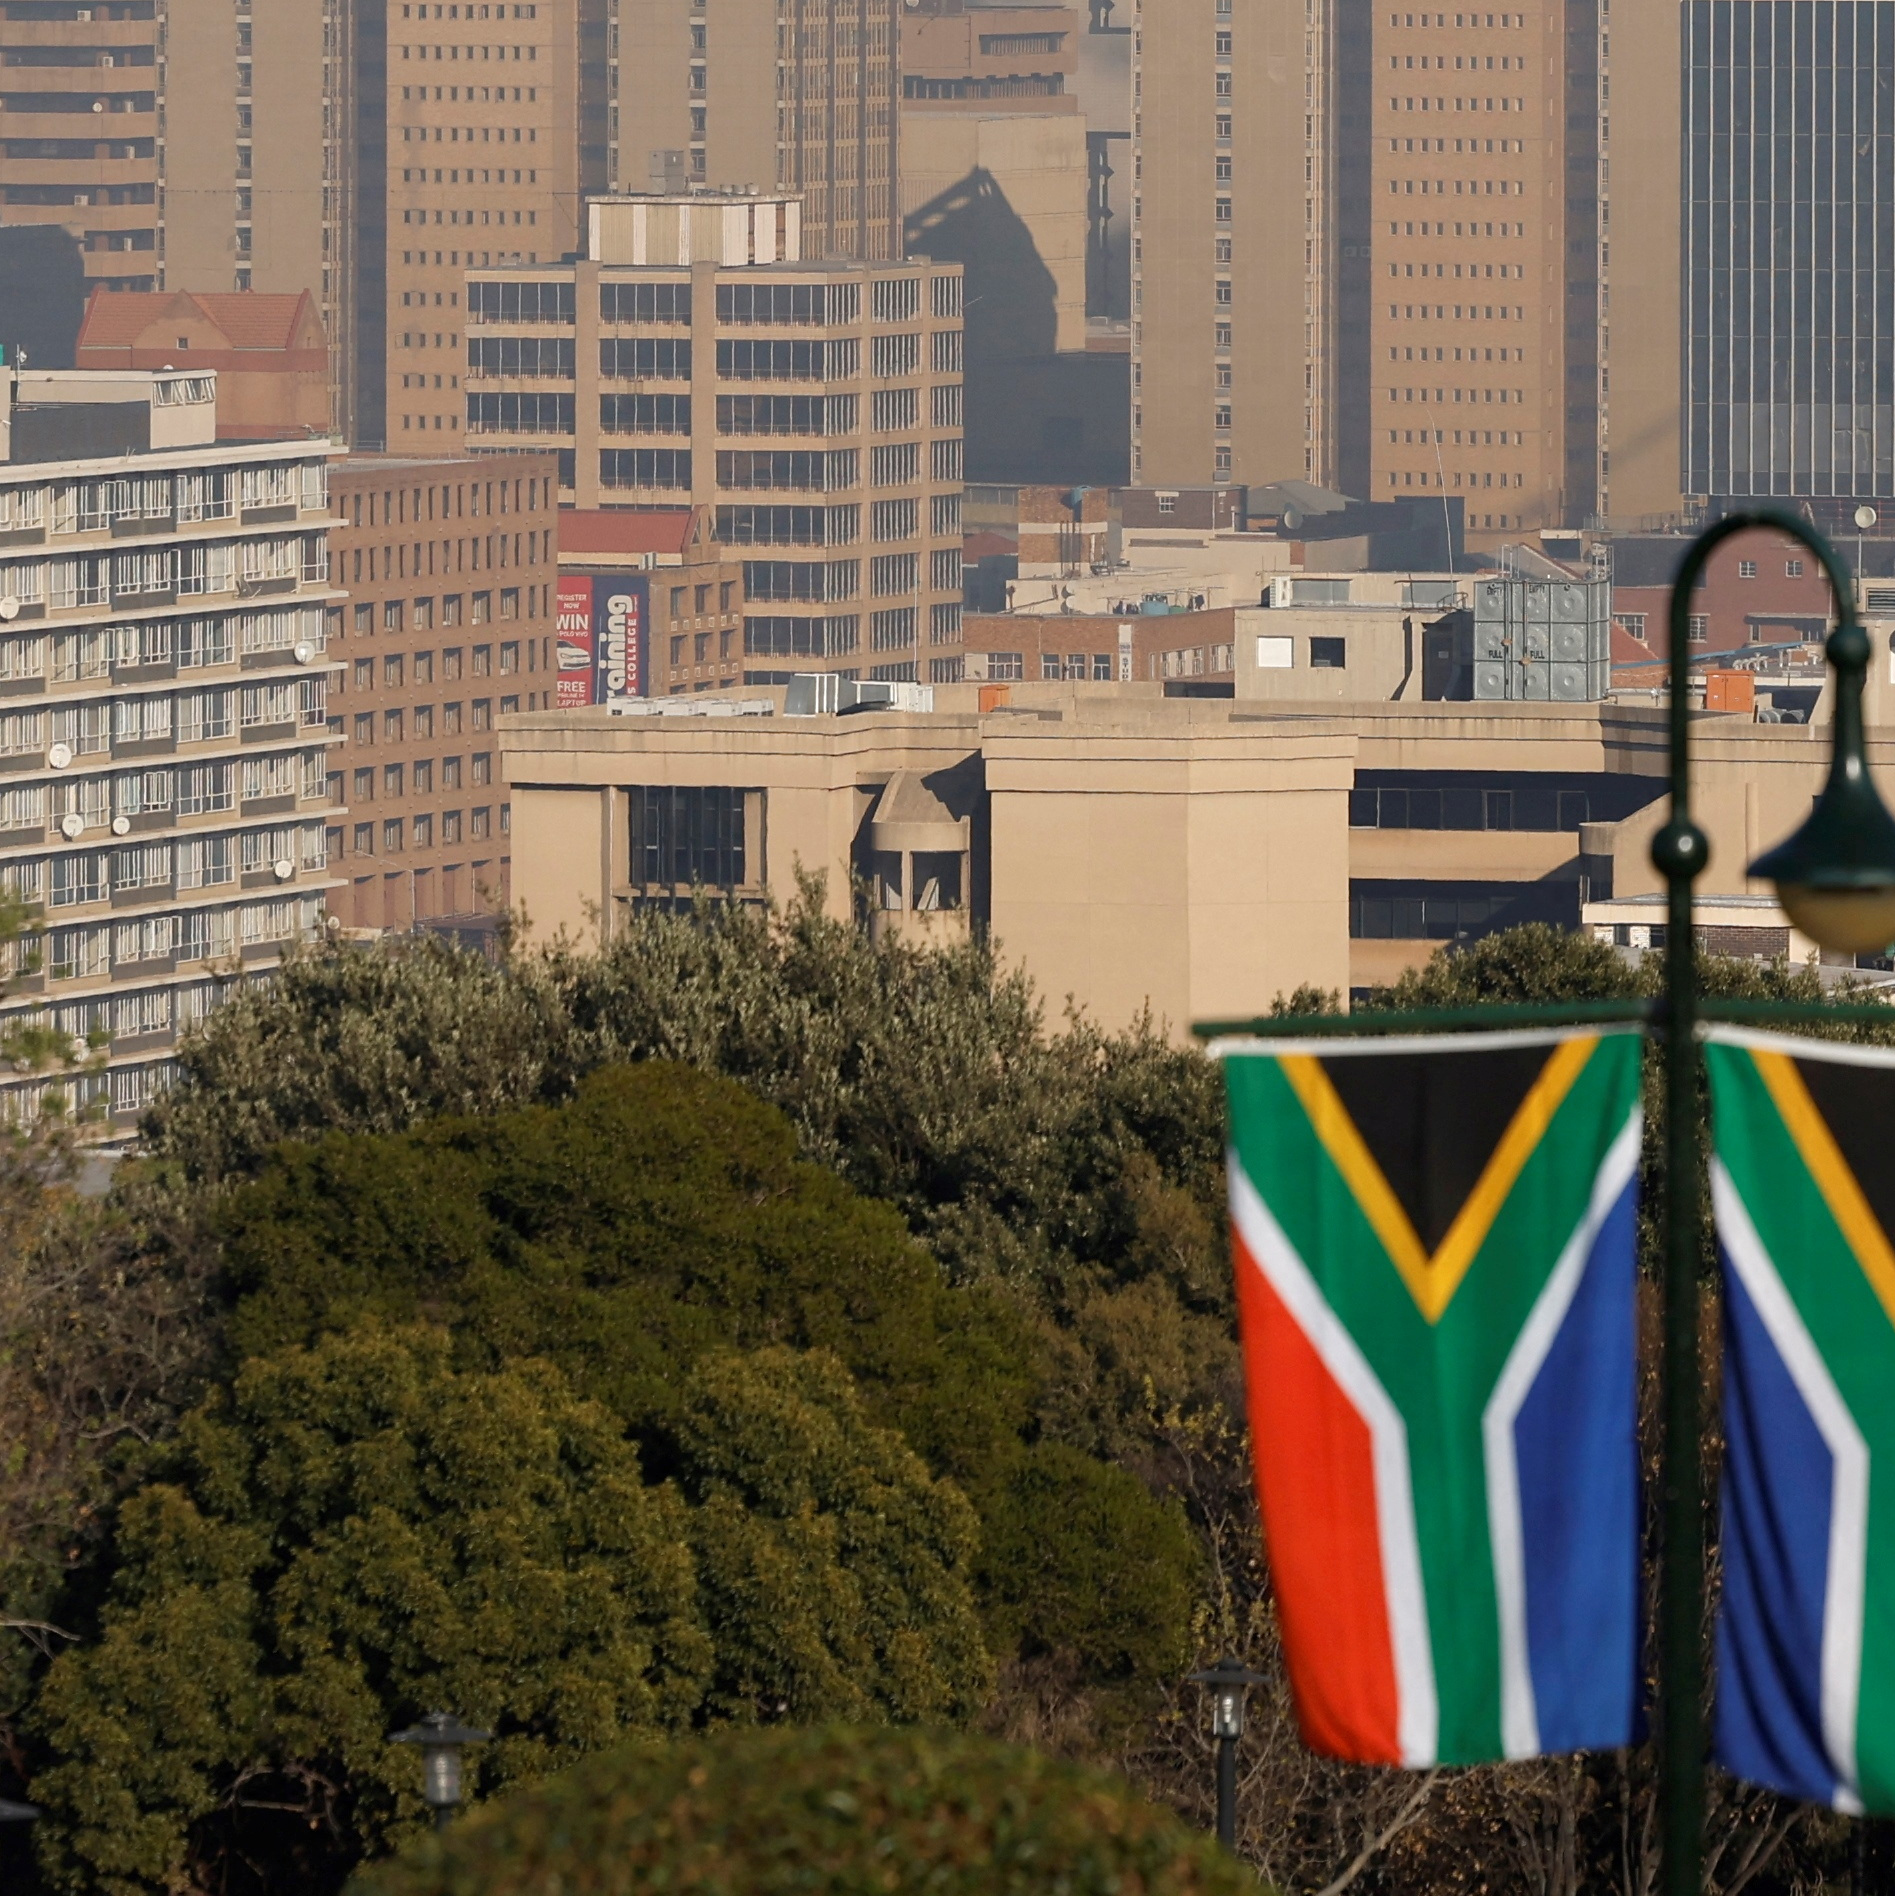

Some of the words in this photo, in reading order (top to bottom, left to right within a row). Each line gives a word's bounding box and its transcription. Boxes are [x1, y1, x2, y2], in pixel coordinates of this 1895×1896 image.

[557, 614, 588, 630] WIN
[627, 619, 637, 681] COLLEGE
[1488, 650, 1502, 659] FULL
[1530, 650, 1545, 659] FULL
[557, 680, 586, 693] FREE
